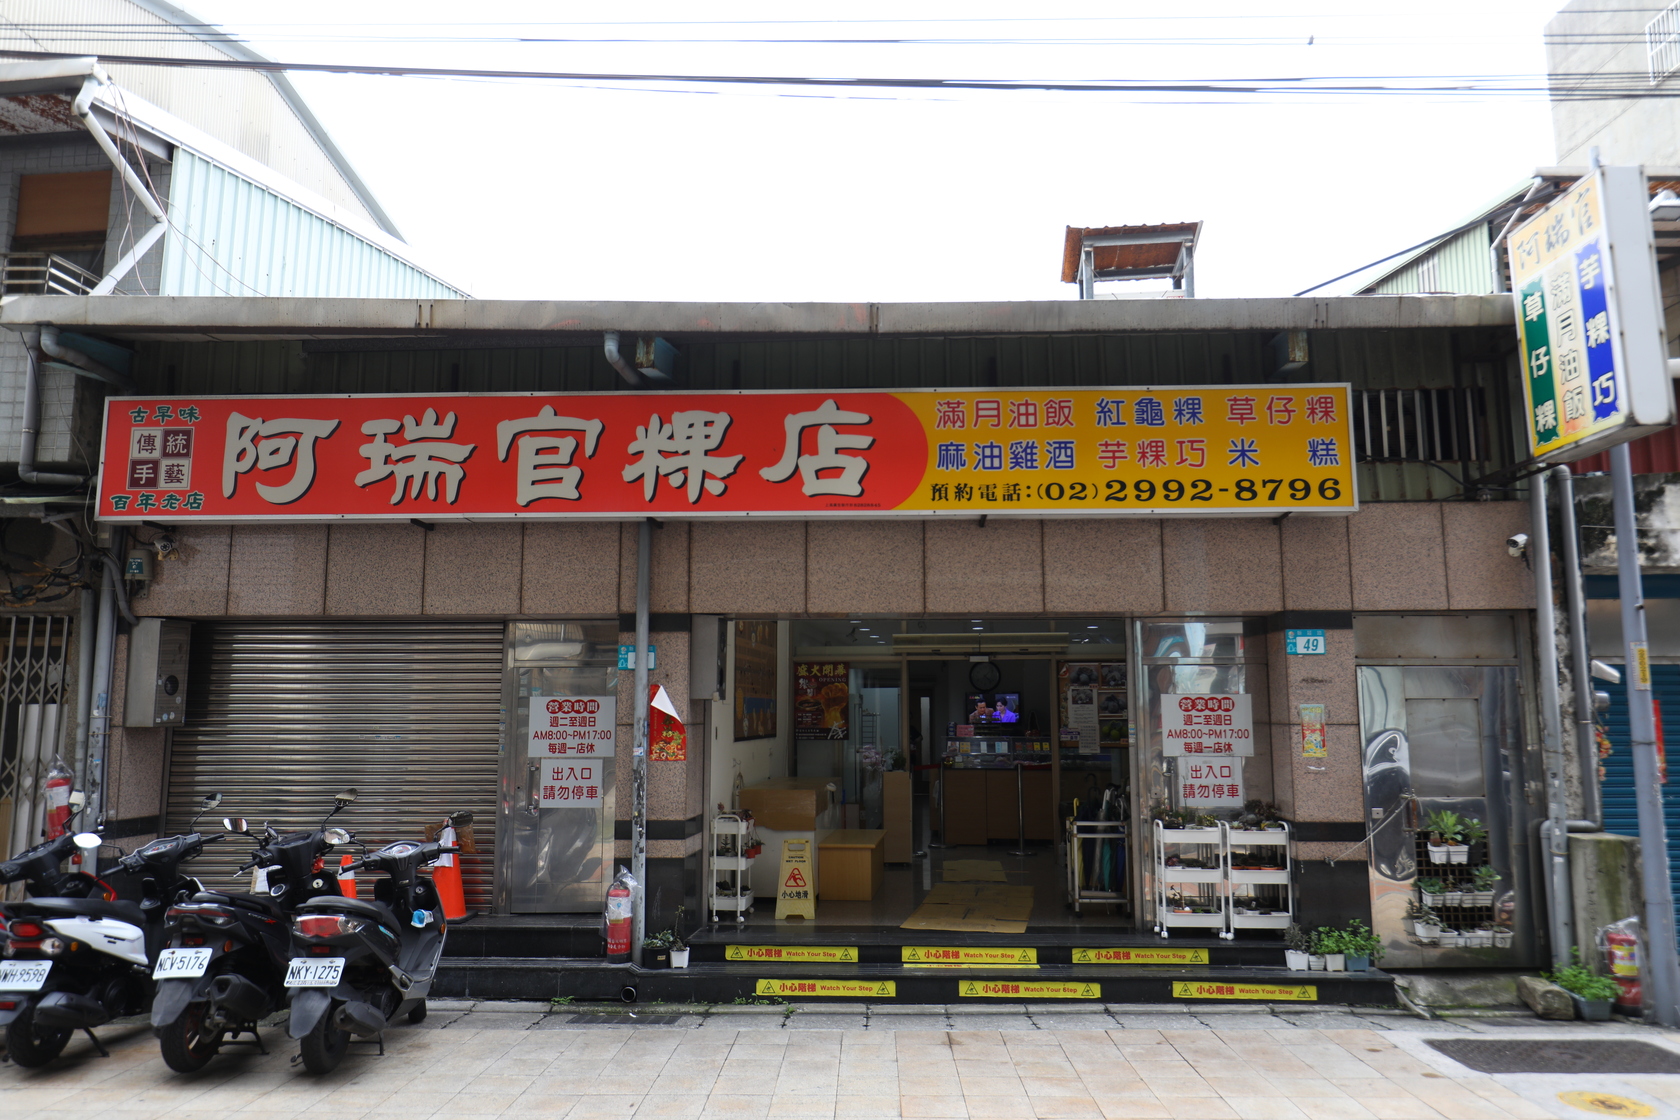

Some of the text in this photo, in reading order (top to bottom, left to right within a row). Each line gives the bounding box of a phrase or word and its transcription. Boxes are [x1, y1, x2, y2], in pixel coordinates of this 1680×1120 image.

[1578, 253, 1616, 406] 芋粿巧
[1550, 271, 1586, 422] 滿月油飯
[1523, 290, 1558, 433] 草仔粿
[129, 405, 202, 425] 古早味
[935, 395, 1338, 430] 滿月油飯 紅龜粿 草仔粿
[136, 432, 190, 455] 傳統
[222, 398, 876, 507] 阿瑞官粿店
[935, 439, 1076, 471] 麻油雞酒
[1097, 438, 1207, 469] 芋粿巧
[133, 463, 187, 486] 手藝
[110, 491, 205, 512] 百年老店
[1303, 638, 1319, 652] 49
[796, 663, 847, 677] 盛大開幕
[547, 700, 599, 713] 營業時間
[1179, 698, 1234, 711] 營業時間
[549, 716, 596, 728] 週二至週日
[1183, 714, 1232, 726] 週二至週日
[532, 729, 612, 741] AM8:00~PM17:00
[1166, 728, 1250, 739] AM8:00~PM17:00
[548, 742, 595, 754] 每週一店休
[1183, 742, 1233, 754] 每週一店休
[552, 766, 592, 781] 出入口
[1190, 765, 1232, 779] 出入口
[543, 785, 599, 800] 請勿停車
[1182, 783, 1240, 798] 請勿停車
[781, 890, 809, 899] 小心地滑
[747, 948, 783, 958] 小心階梯
[822, 951, 837, 959] Step
[924, 949, 961, 960] 小心階梯
[963, 951, 983, 959] Watch
[1000, 952, 1015, 960] Step
[1094, 950, 1187, 961] 小心階梯 Watch Your Step
[156, 955, 208, 973] NCV-5176
[288, 965, 341, 980] NKY-1275
[779, 982, 873, 993] 小心階梯 Watch Your Step
[982, 983, 1078, 995] 小心階梯 Watch Your Step
[1196, 985, 1294, 997] 小心階梯 Watch Your Step
